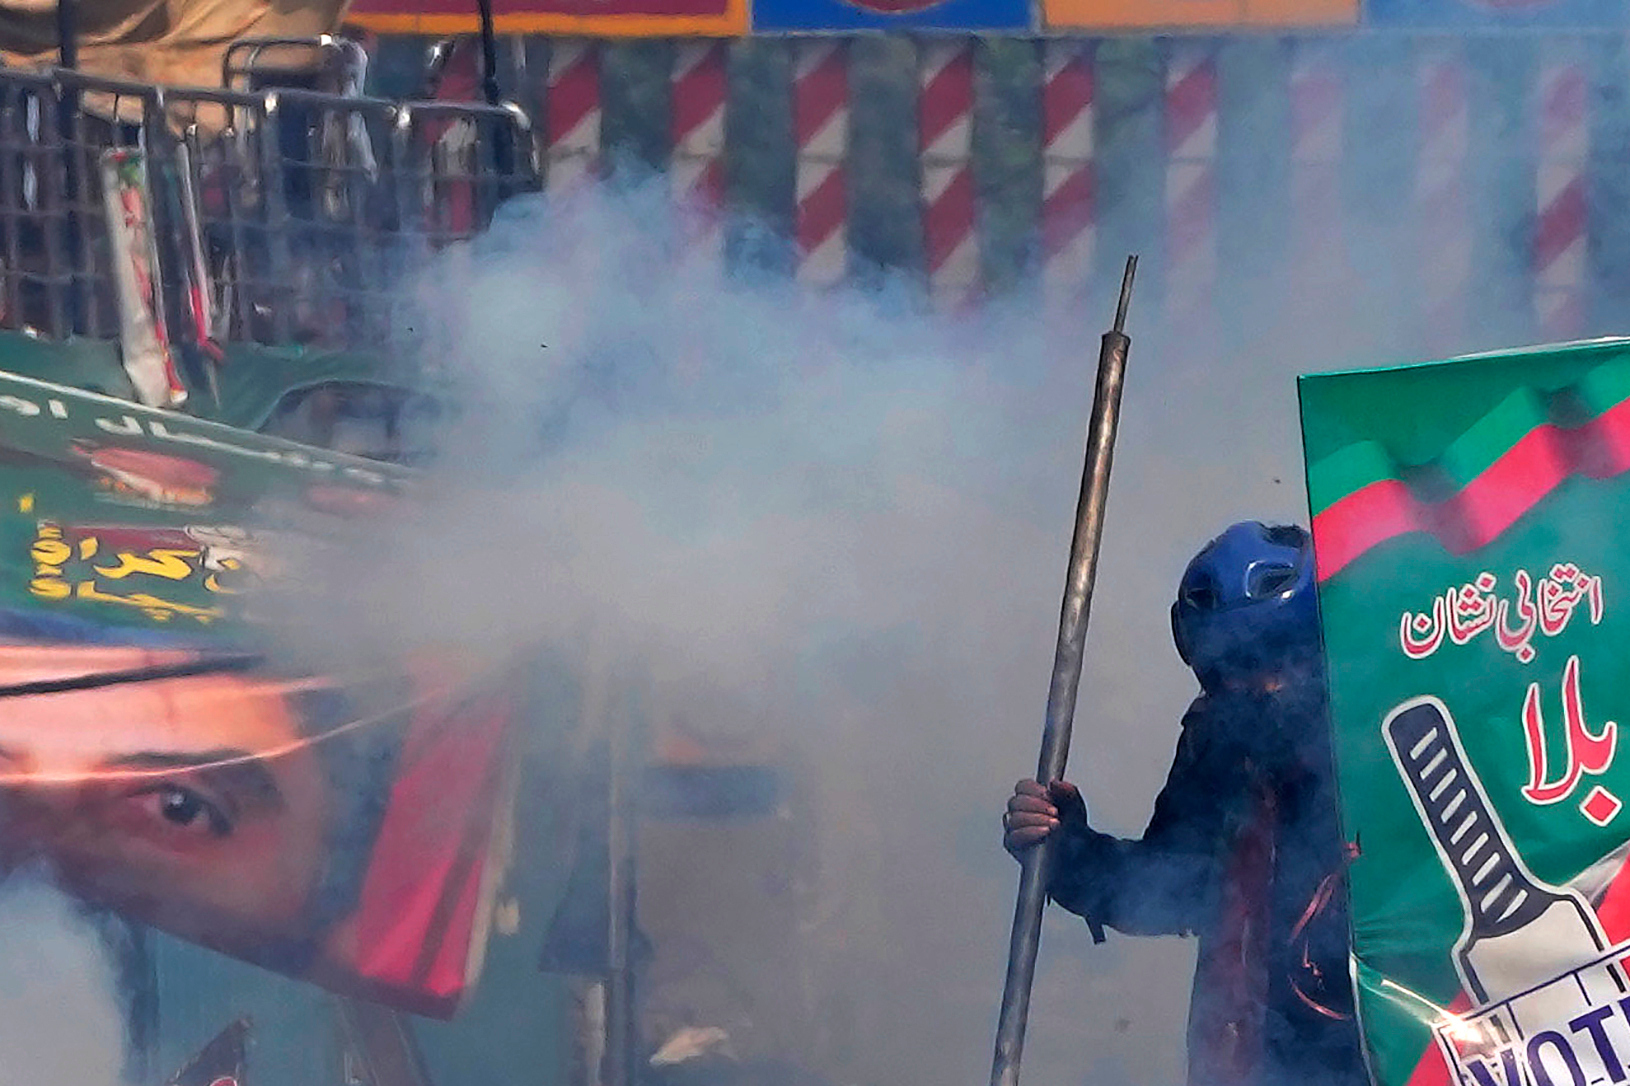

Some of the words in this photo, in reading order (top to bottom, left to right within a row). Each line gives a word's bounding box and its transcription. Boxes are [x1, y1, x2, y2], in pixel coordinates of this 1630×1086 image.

[1400, 572, 1495, 659] نشان
[1496, 563, 1603, 663] انتخابی
[1521, 656, 1622, 826] بلا
